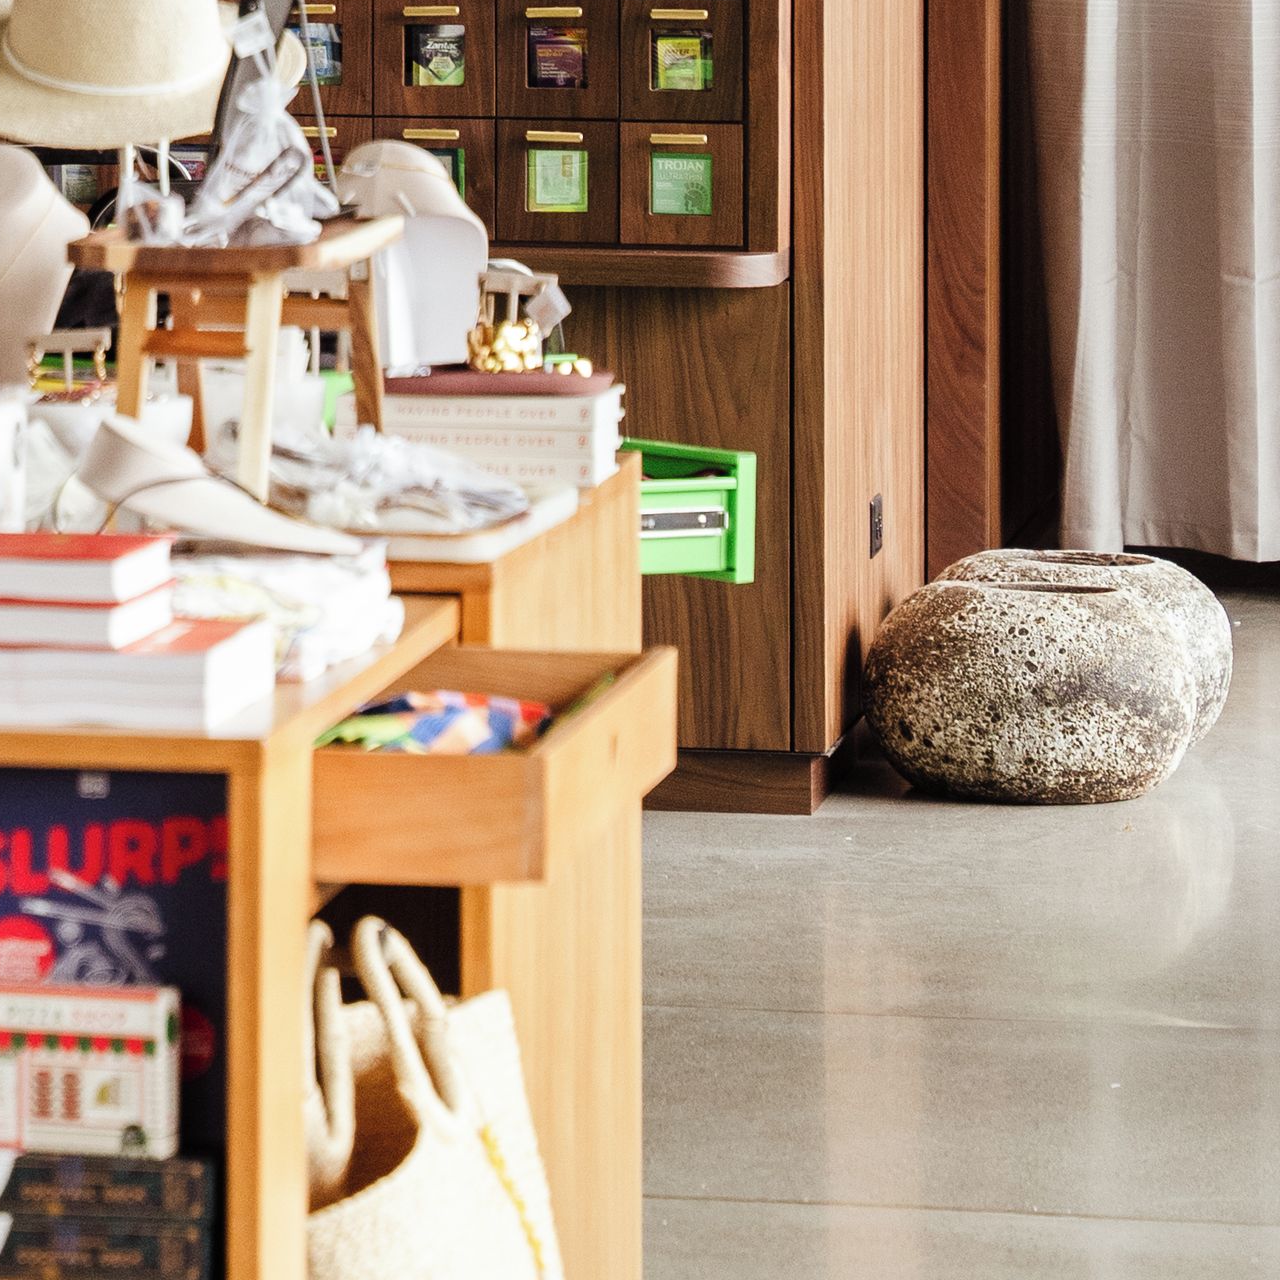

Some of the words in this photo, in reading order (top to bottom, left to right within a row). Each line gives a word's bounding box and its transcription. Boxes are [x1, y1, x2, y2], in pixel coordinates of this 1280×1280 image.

[426, 41, 458, 50] Zantac
[656, 159, 705, 171] TROJAN
[455, 407, 511, 417] PEOPLE
[519, 409, 557, 419] OVER
[455, 435, 510, 446] PEOPLE
[518, 437, 556, 448] OVER
[519, 466, 557, 477] OVER
